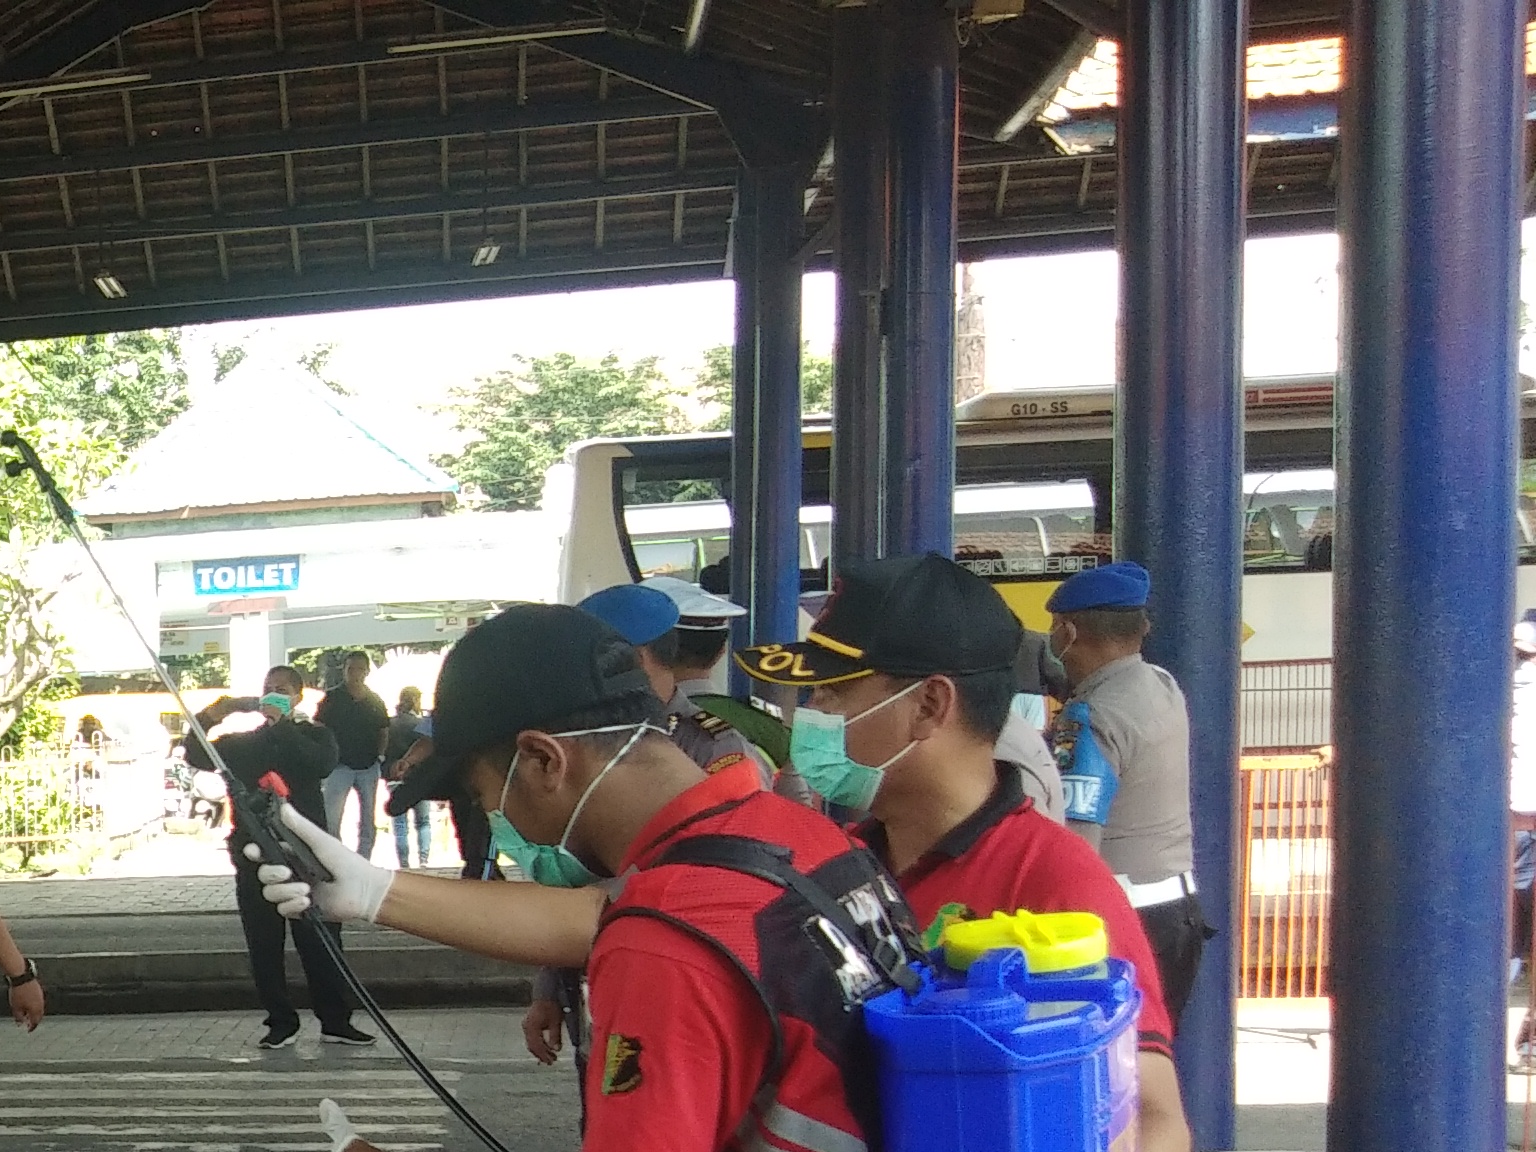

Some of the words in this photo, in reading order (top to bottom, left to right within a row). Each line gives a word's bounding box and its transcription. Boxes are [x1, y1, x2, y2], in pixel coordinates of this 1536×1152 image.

[1011, 403, 1038, 416] G10
[1050, 401, 1069, 413] SS
[197, 563, 296, 590] TOILET
